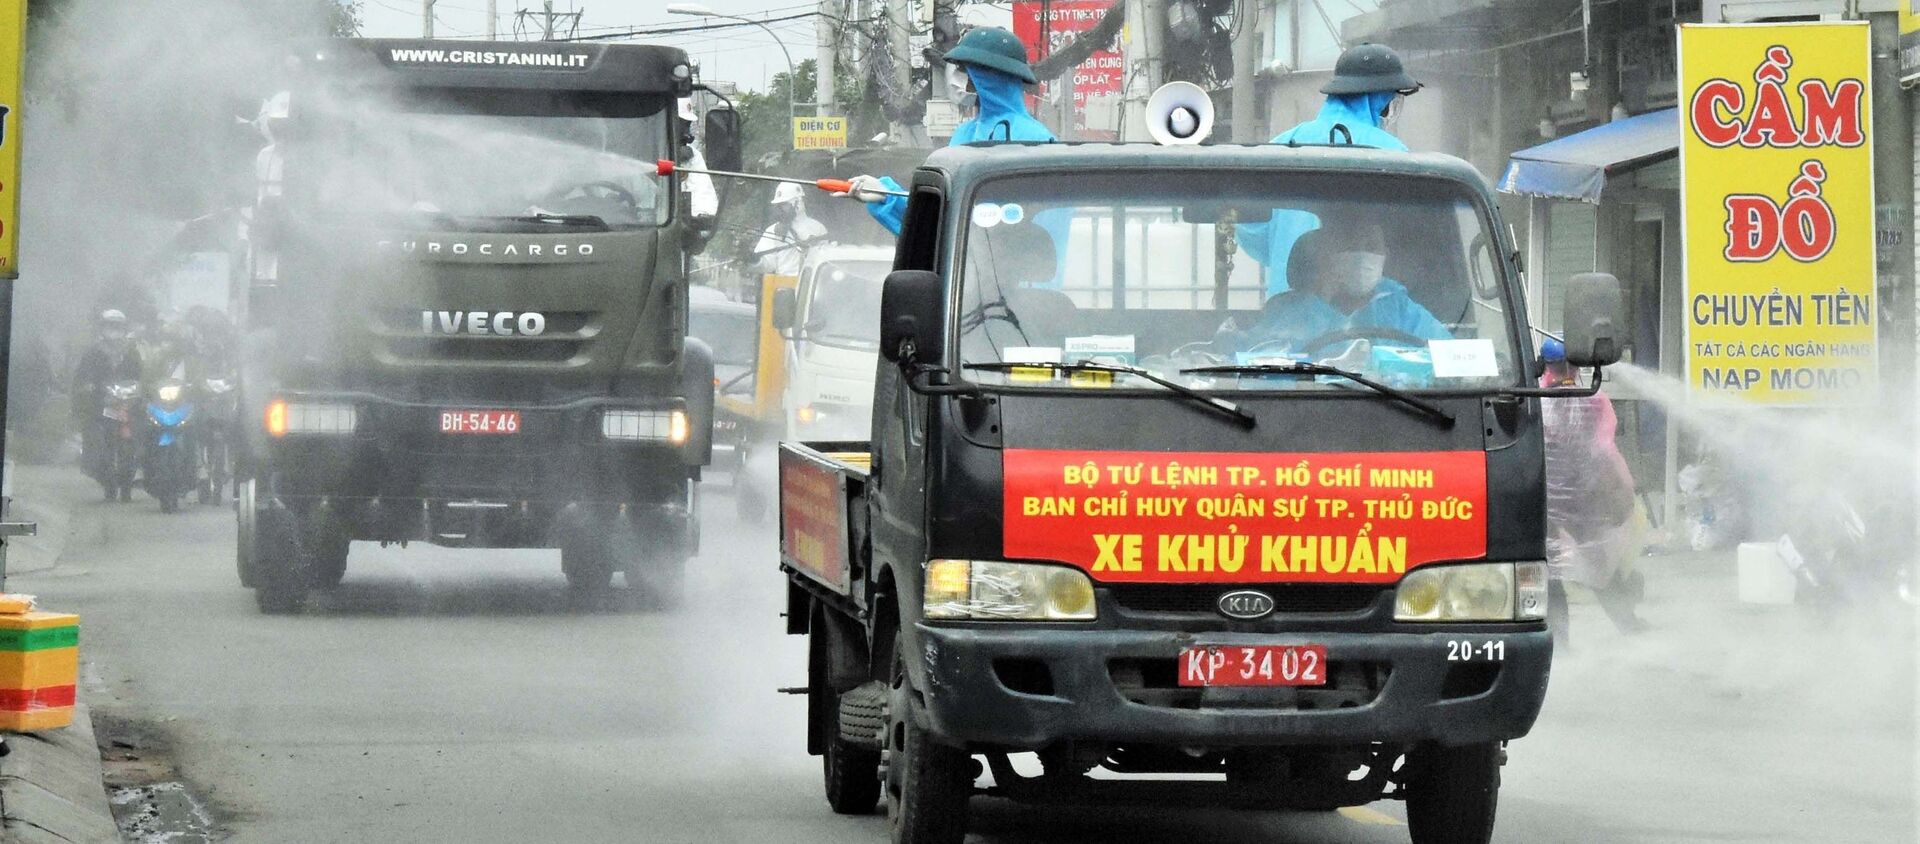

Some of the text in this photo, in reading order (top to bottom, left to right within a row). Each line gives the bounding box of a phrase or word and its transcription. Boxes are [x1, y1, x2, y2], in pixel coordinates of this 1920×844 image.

[391, 49, 588, 67] WWW.CRISTANINI.IT
[1690, 45, 1865, 148] CẦM
[1724, 159, 1836, 263] ĐỒ
[1693, 287, 1870, 327] CHUYỂN TIỀN
[422, 310, 546, 337] IVECO
[1750, 341, 1780, 357] CÁC
[1785, 340, 1825, 357] NGÂN
[1771, 367, 1861, 390] MOMO
[442, 413, 517, 431] BH-54-46
[1063, 459, 1434, 490] BỘ TƯ LỆNH TP. HỒ CHÍ MINH
[1023, 489, 1473, 522] BAN CHỈ HUY QUÂN SỰ TP. THỦ ĐỨC
[1091, 521, 1408, 574] XE KHỬ KHUẨN
[1228, 597, 1266, 612] KIA
[1447, 640, 1505, 661] 20-11
